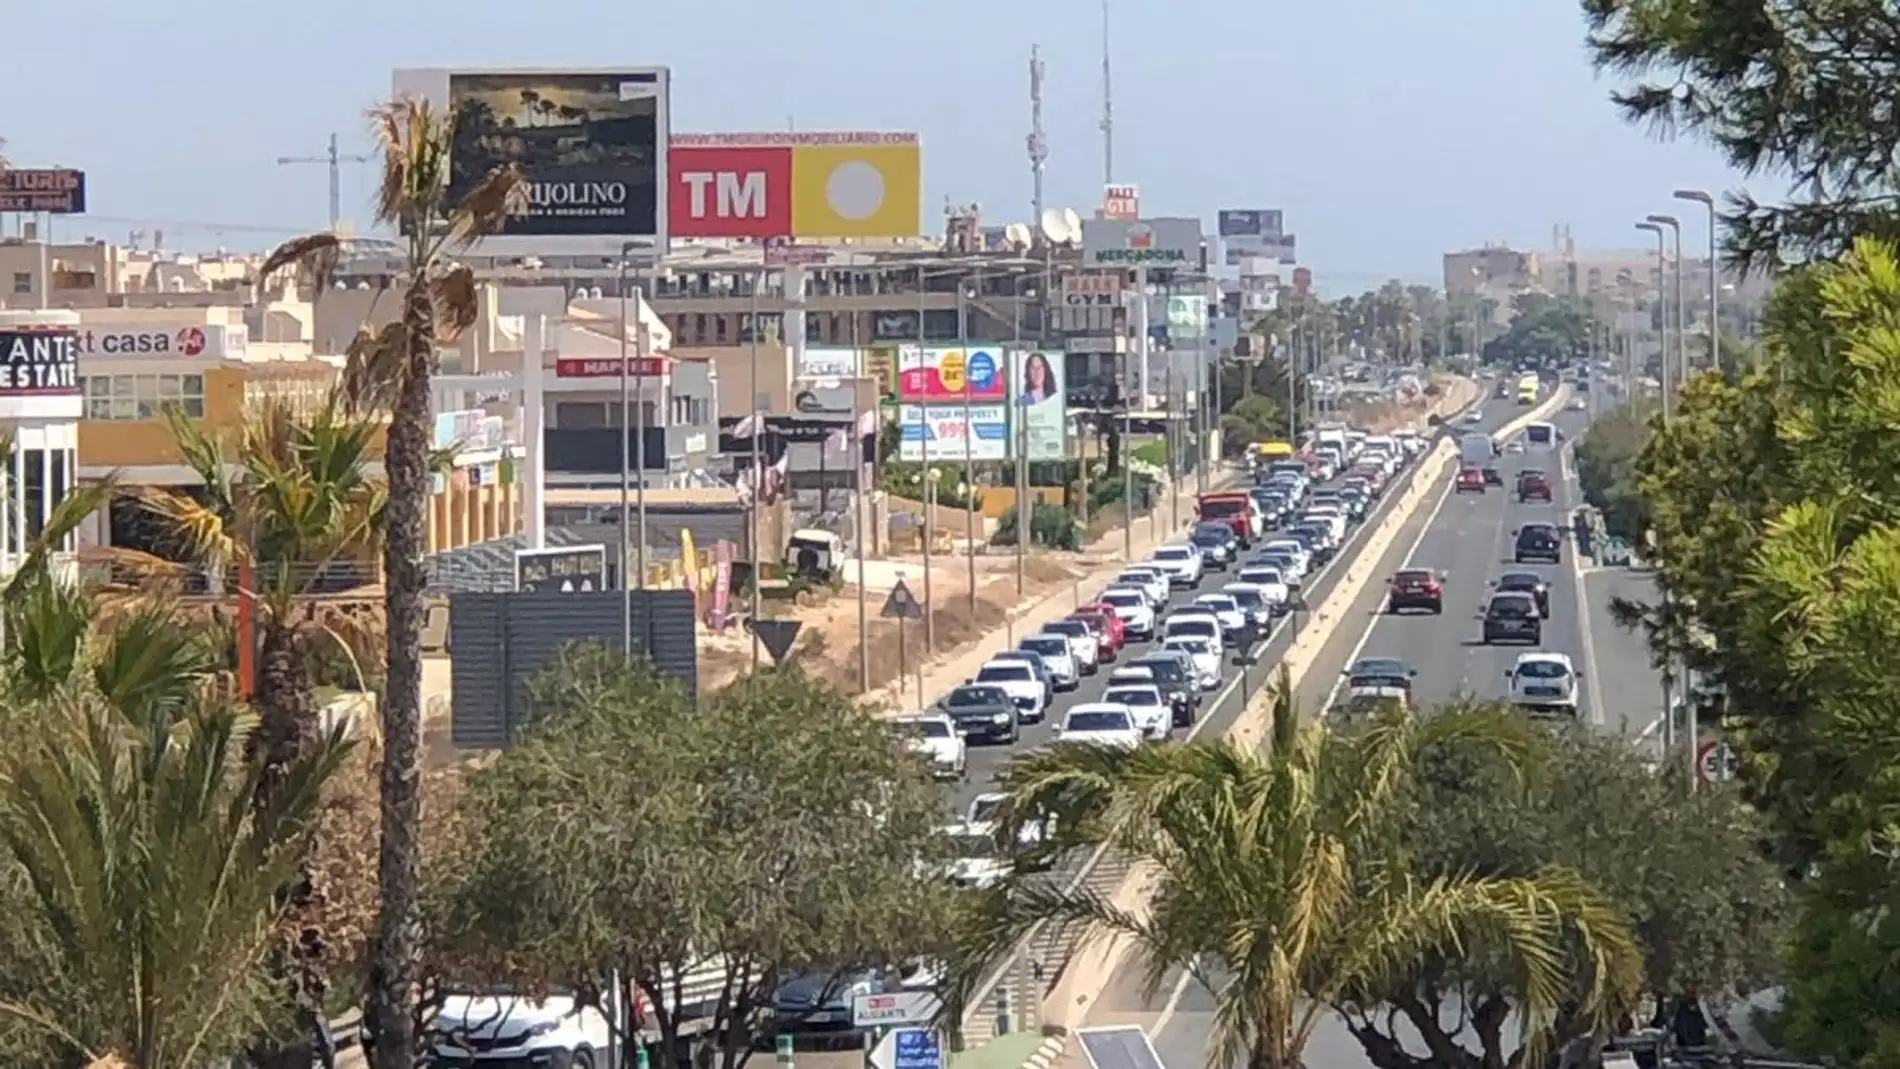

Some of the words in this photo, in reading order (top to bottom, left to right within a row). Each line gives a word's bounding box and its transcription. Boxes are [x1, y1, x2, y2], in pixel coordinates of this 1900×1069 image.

[681, 171, 767, 218] TM
[1095, 249, 1186, 263] MERCADONA
[1067, 294, 1111, 305] GYM
[102, 333, 169, 353] casa
[0, 363, 75, 387] ESTATE
